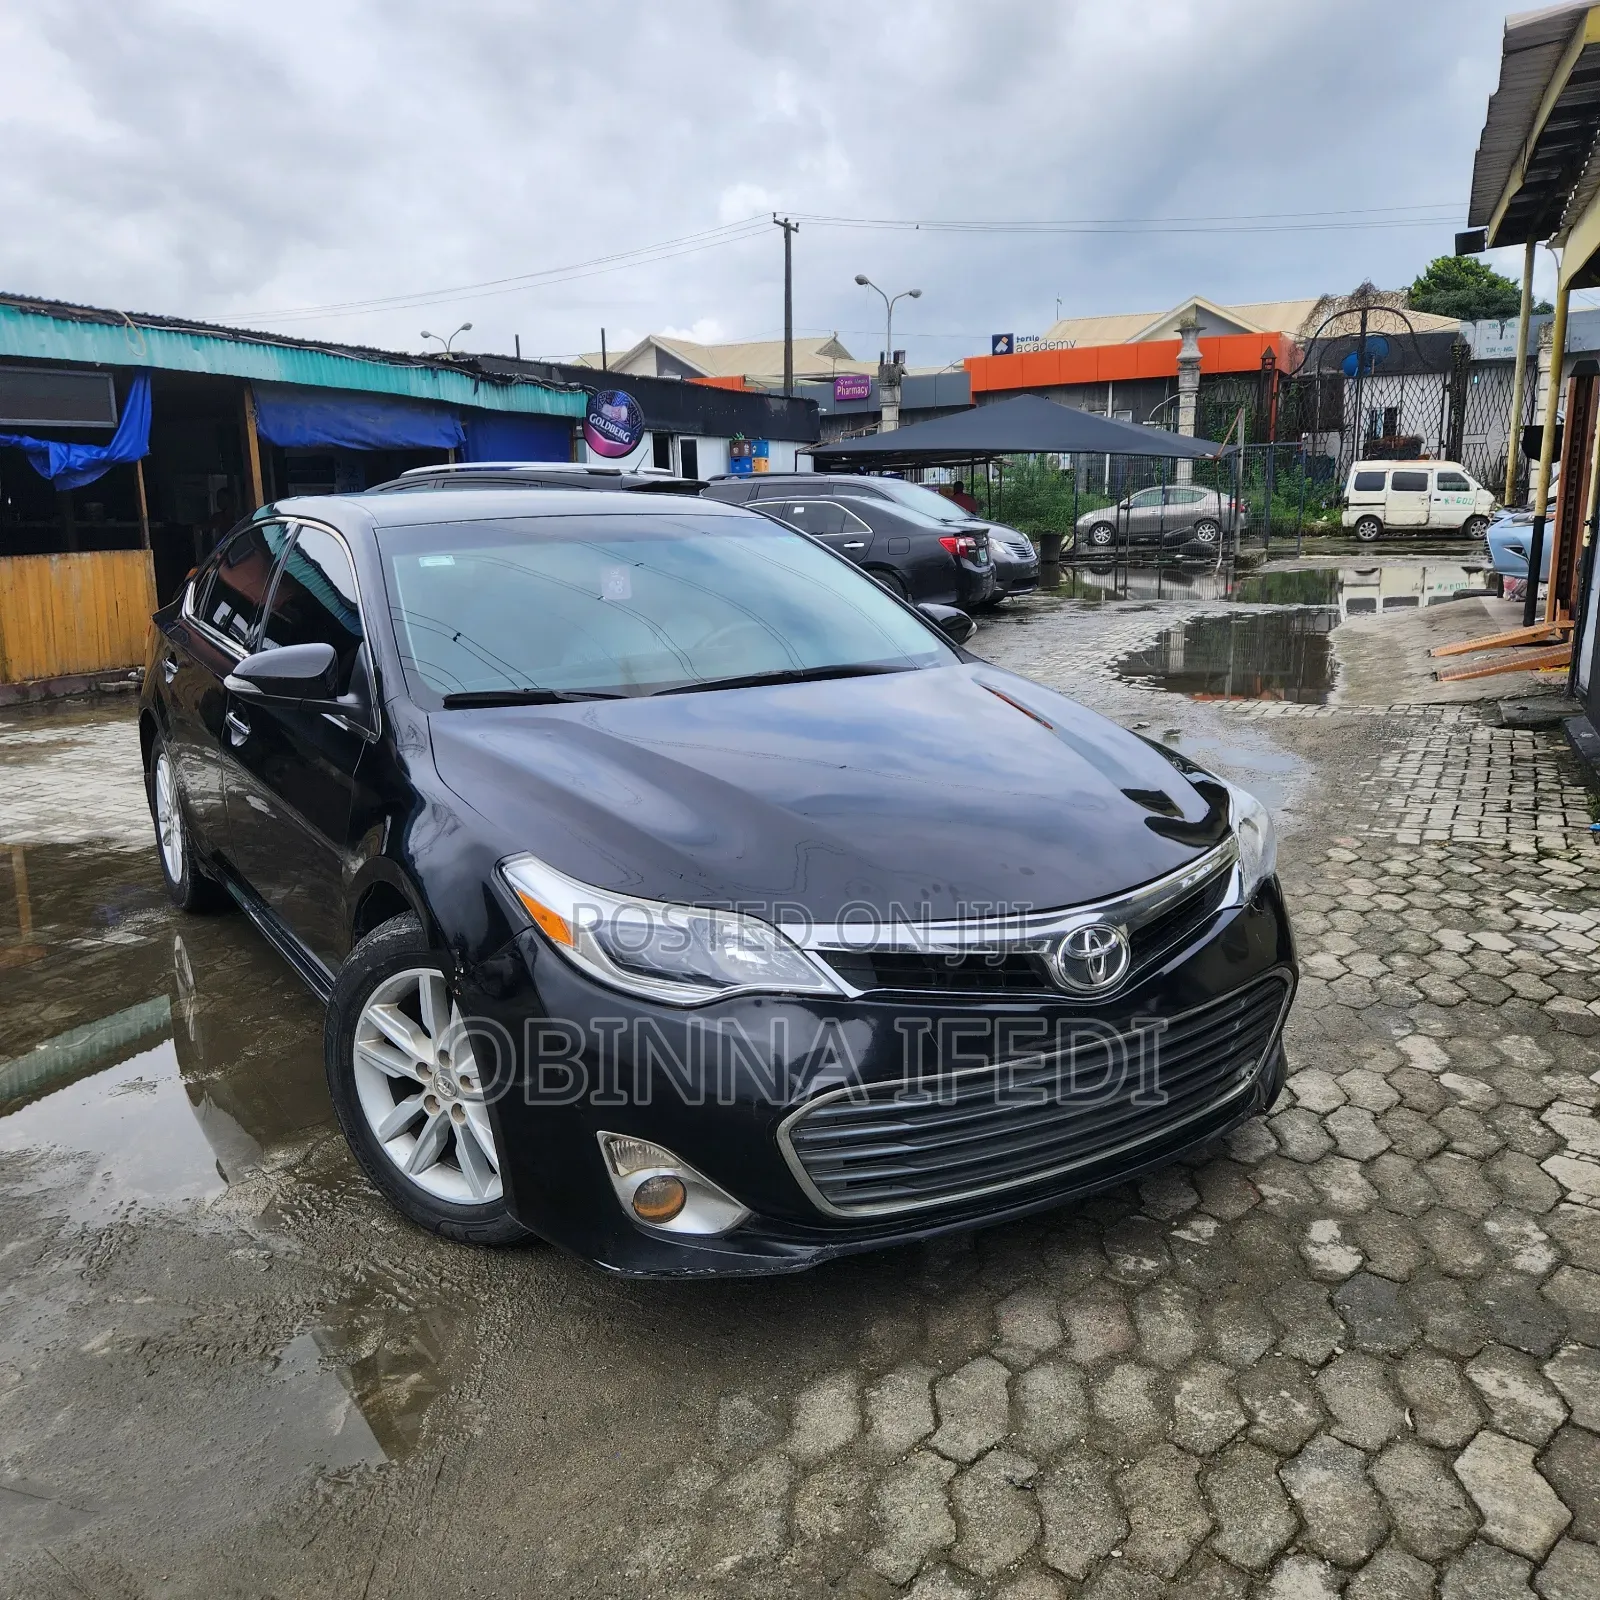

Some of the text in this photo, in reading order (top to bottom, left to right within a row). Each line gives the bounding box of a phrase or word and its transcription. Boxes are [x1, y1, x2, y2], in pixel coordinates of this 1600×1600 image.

[1015, 340, 1077, 353] academy
[837, 385, 869, 396] Pharmacy
[589, 413, 630, 442] GOLDBERG
